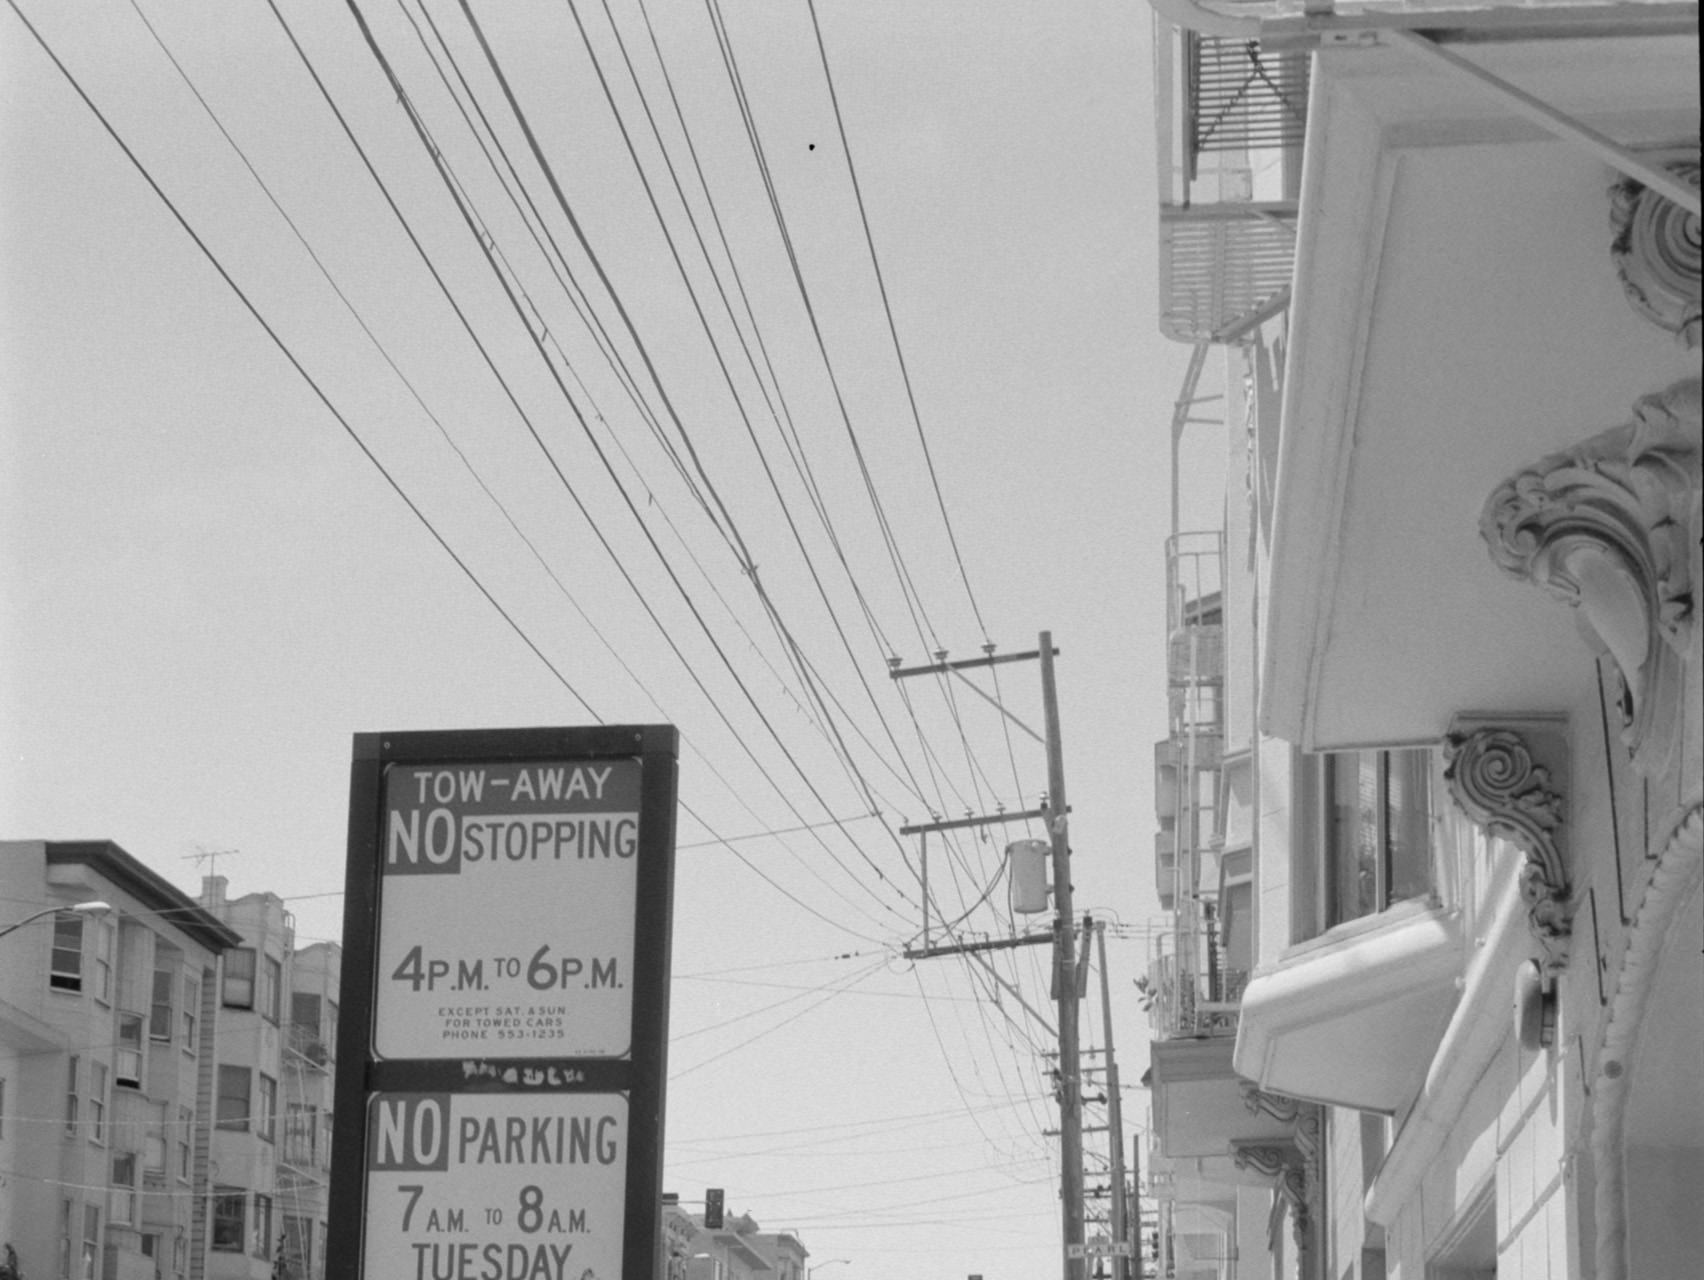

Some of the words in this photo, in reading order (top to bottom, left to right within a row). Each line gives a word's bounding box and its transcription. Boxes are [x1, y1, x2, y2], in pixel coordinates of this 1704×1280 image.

[389, 808, 455, 864] NO
[463, 819, 637, 862] STOPPING
[494, 957, 521, 978] TO
[438, 1007, 489, 1016] EXCEPT
[445, 1019, 470, 1028] FOR
[477, 1018, 520, 1027] TOWED
[526, 1017, 562, 1027] CARS
[443, 1030, 487, 1040] PHONE
[498, 1029, 564, 1039] 553-1235
[378, 1099, 441, 1165] NO
[459, 1116, 617, 1165] PARKING
[485, 1208, 502, 1225] TO
